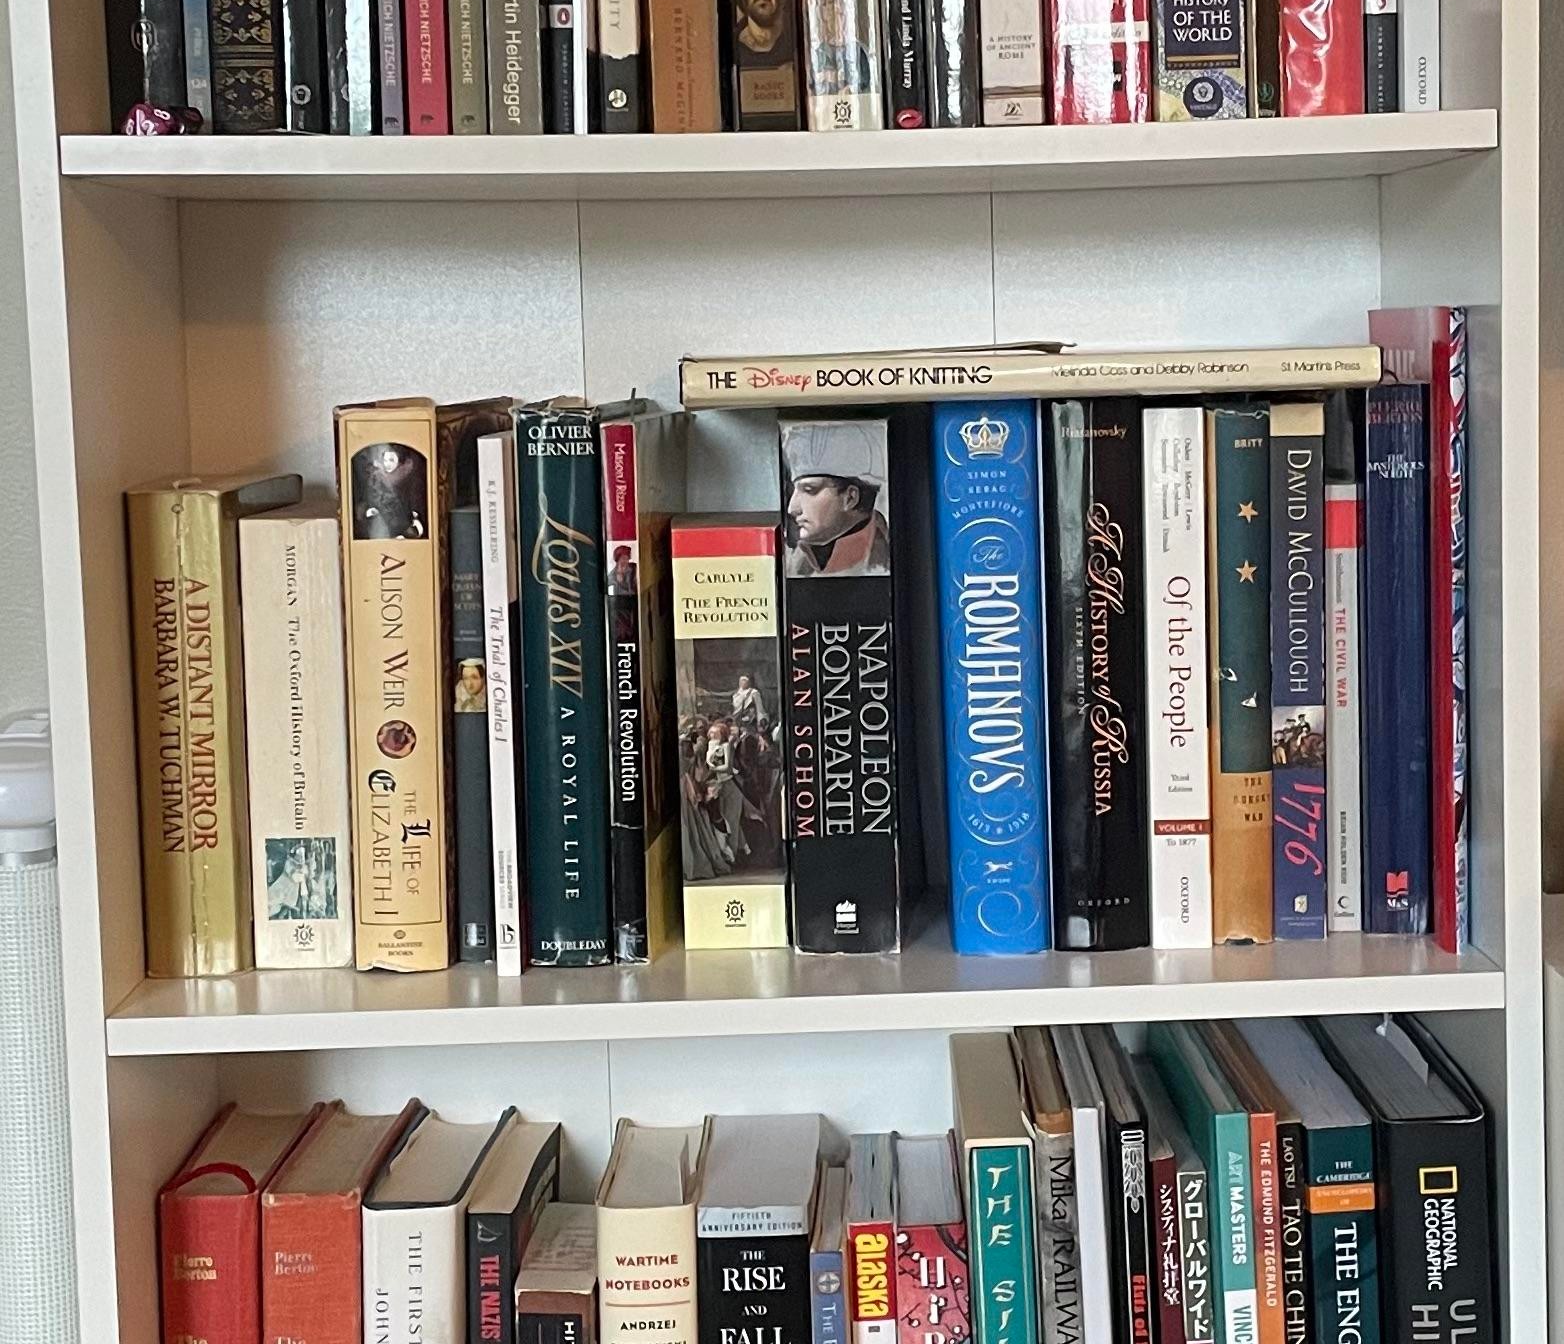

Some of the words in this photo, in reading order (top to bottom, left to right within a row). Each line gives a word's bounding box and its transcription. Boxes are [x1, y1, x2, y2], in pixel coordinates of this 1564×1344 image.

[1174, 12, 1194, 26] OF
[1199, 11, 1231, 25] THE
[1174, 28, 1232, 42] WORLD
[385, 22, 397, 86] NIETZSCHE
[421, 20, 433, 83] NIETZSCHE
[462, 21, 474, 84] NIETZSCHE
[502, 30, 524, 123] Heidegger
[528, 426, 592, 439] OLIVIER
[528, 442, 595, 456] BERNIER
[1234, 438, 1263, 448] BRITT
[613, 443, 626, 512] Mason/Rizzo
[967, 470, 1007, 479] SIMON
[184, 578, 210, 591] A
[284, 545, 298, 605] MORGAN
[694, 572, 754, 583] CARLYLE
[1167, 575, 1192, 611] Of
[682, 597, 712, 609] THE
[716, 597, 768, 609] FRENCH
[684, 611, 768, 623] REVOLUTION
[153, 578, 180, 691] BARBARA
[287, 617, 301, 644] The
[1169, 617, 1191, 657] the
[187, 603, 214, 725] DISTANT
[288, 649, 304, 701] Oxford
[617, 642, 637, 700] French
[792, 624, 814, 715] ALAN
[958, 572, 1025, 794] ROMANOVS
[158, 695, 180, 721] W.
[561, 707, 574, 719] A
[822, 622, 855, 836] BONAPARTE
[858, 621, 892, 835] NAPOLEON
[1168, 664, 1192, 747] People
[288, 706, 305, 758] History
[619, 709, 639, 802] Revolution
[159, 725, 184, 853] TUCHMAN
[190, 732, 218, 852] MIRROR
[293, 763, 306, 777] of
[562, 735, 579, 825] ROYAL
[794, 725, 816, 838] SCHOM
[294, 781, 307, 830] Britain
[1277, 781, 1325, 875] 1776
[565, 840, 580, 900] LIFE
[1181, 877, 1189, 923] OXFORD
[541, 939, 606, 950] DOUBLEDAY
[1260, 1140, 1271, 1165] THE
[1282, 1137, 1295, 1159] LAO
[1261, 1169, 1274, 1221] EDMUND
[1284, 1163, 1296, 1189] TSU
[1283, 1199, 1301, 1245] TAO
[1425, 1198, 1443, 1291] GEOGRAPHIC
[1441, 1197, 1457, 1270] NATIONAL
[408, 1231, 422, 1276] THE
[615, 1254, 678, 1267] WARTIME
[741, 1250, 765, 1261] THE
[1264, 1227, 1277, 1307] FITZGERALD
[1284, 1251, 1303, 1282] TE
[1333, 1222, 1360, 1282] THE
[607, 1277, 690, 1291] NOTEBOOKS
[723, 1266, 785, 1291] RISE
[375, 1288, 389, 1344] JOHN
[620, 1319, 676, 1330] ANDRZEJ
[742, 1305, 767, 1315] AND
